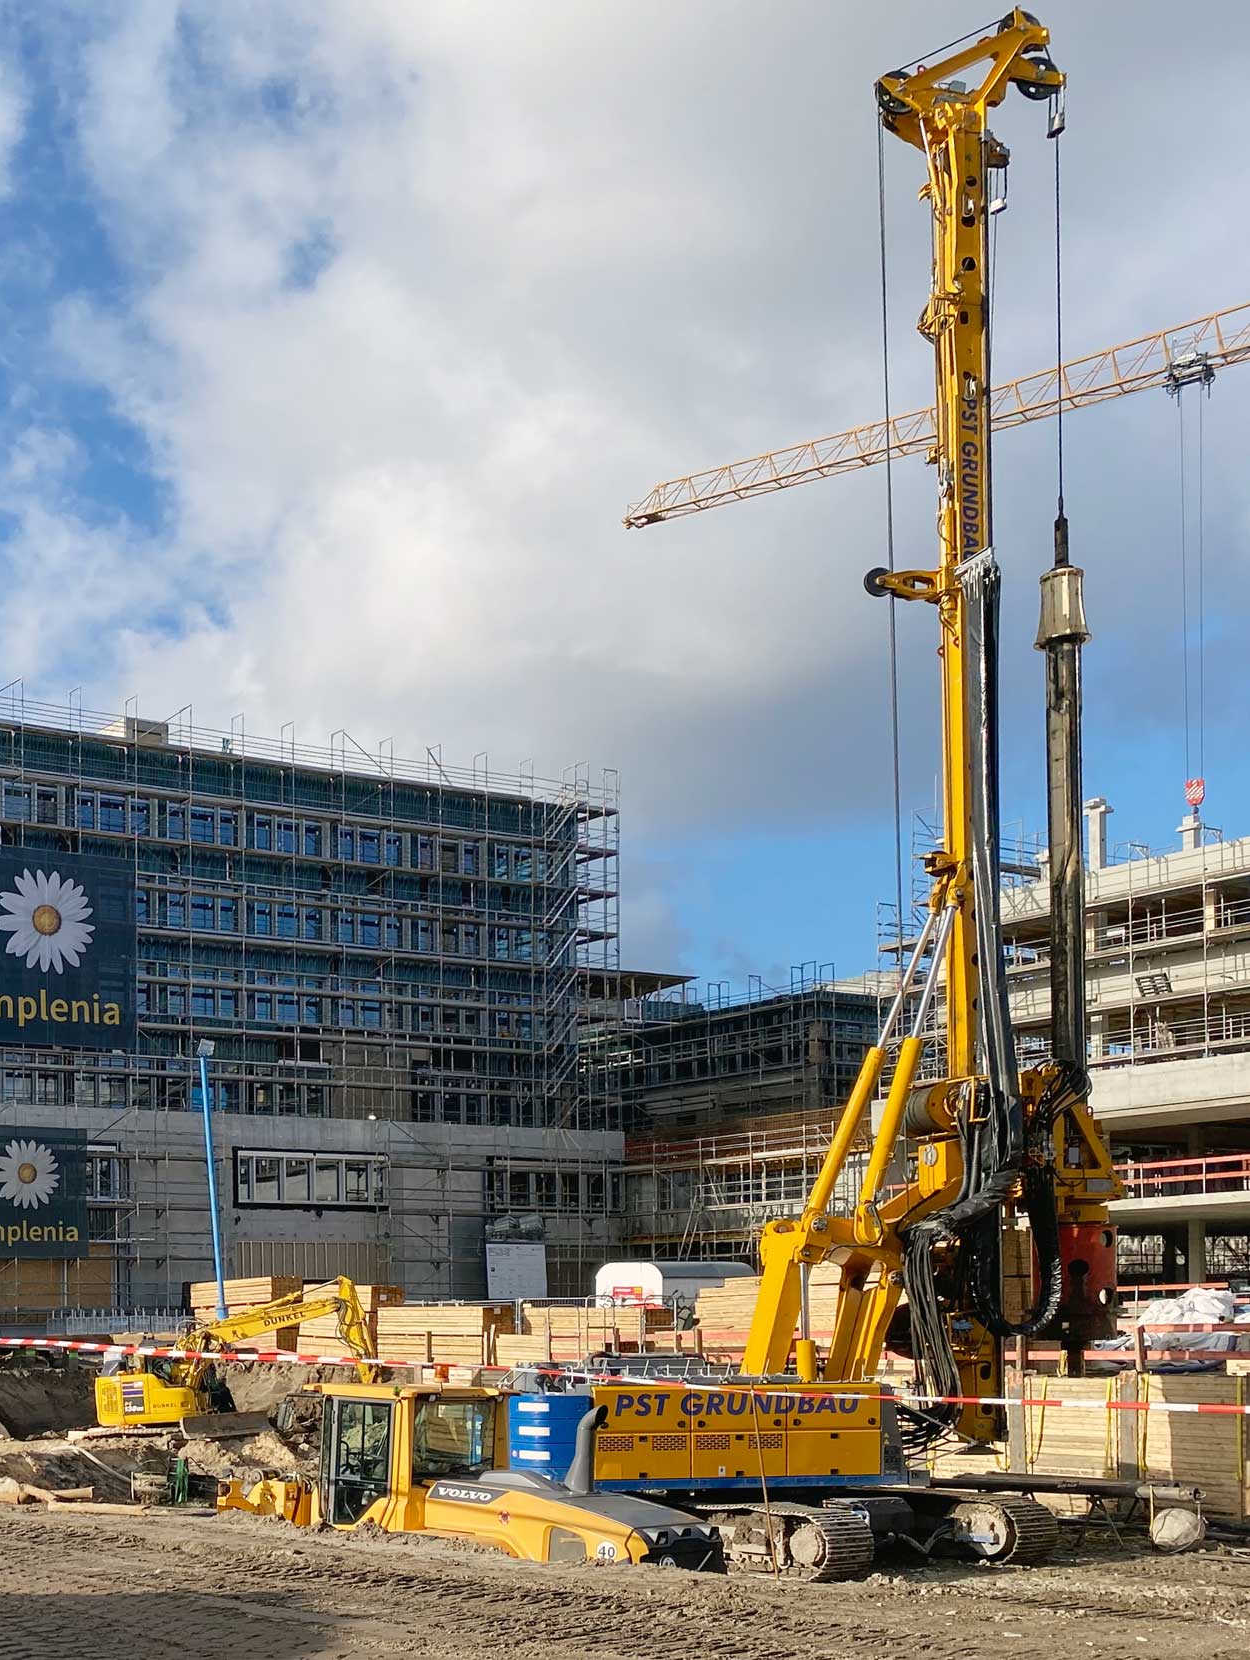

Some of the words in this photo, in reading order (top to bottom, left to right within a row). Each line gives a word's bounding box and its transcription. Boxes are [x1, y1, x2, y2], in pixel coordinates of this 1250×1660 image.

[961, 398, 978, 436] PST
[263, 1311, 307, 1327] DUNKEL
[152, 1402, 180, 1410] DUNKEL
[614, 1394, 671, 1417] PST
[680, 1391, 862, 1415] GRUNDBAU
[437, 1486, 493, 1502] VOLVO
[598, 1545, 616, 1559] 40
